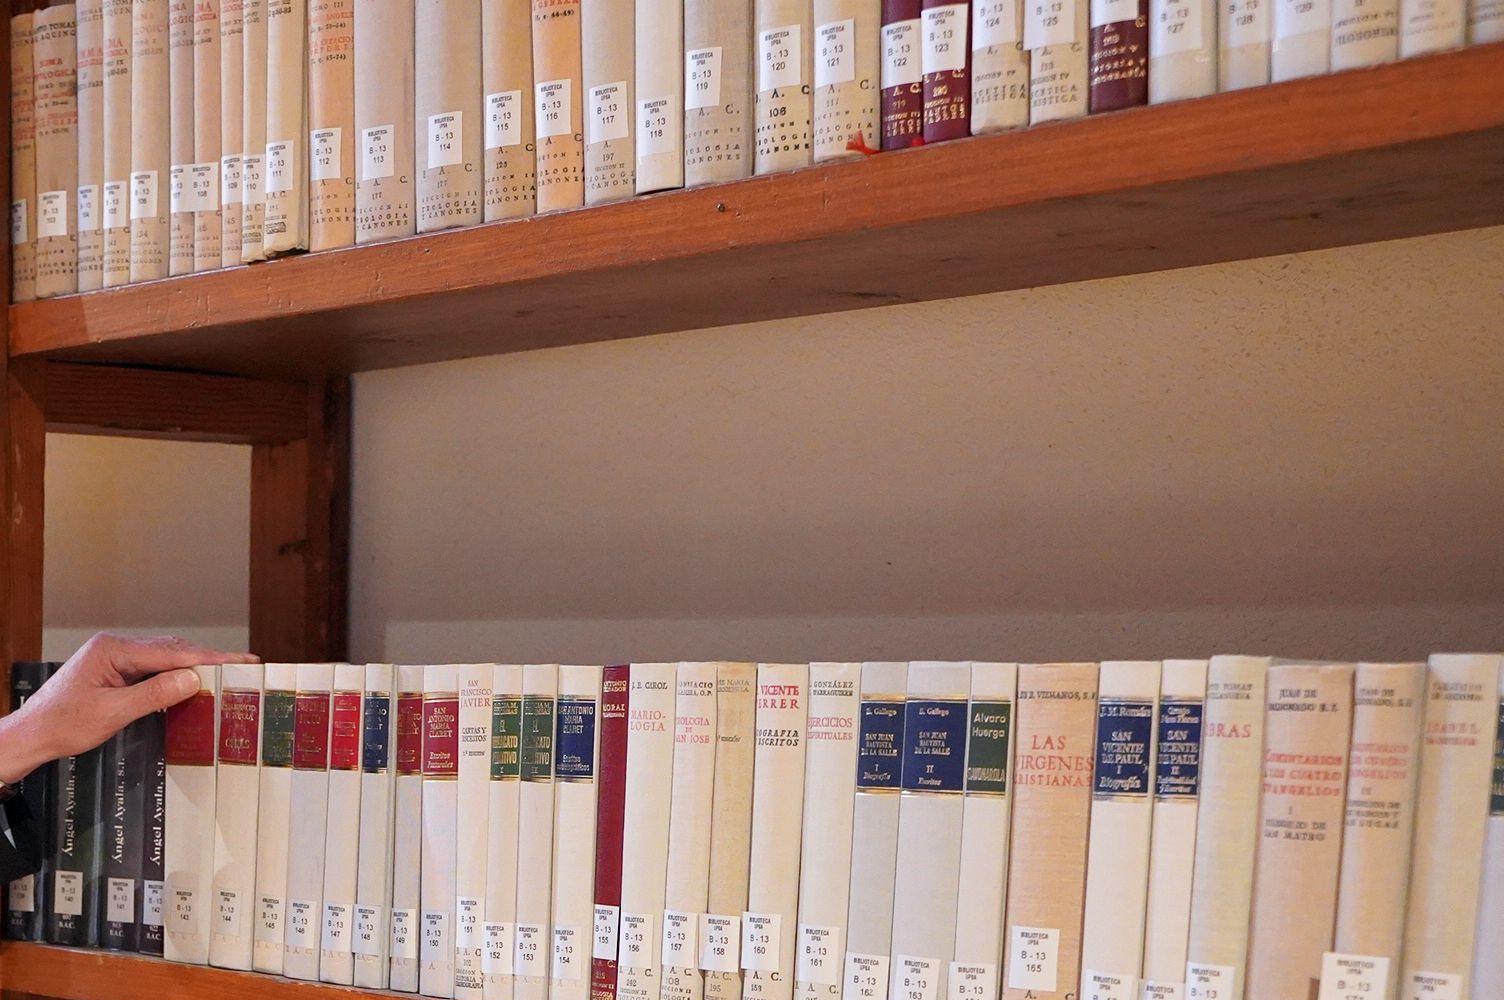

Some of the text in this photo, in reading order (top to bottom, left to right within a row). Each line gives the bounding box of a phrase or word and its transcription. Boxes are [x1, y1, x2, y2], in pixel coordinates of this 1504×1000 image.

[985, 17, 1001, 27] 124
[934, 43, 949, 53] 123
[771, 61, 786, 71] 120
[826, 57, 840, 66] 121
[893, 57, 907, 67] 122
[695, 82, 709, 91] 119
[545, 112, 558, 121] 116
[602, 115, 615, 124] 117
[497, 123, 509, 131] 115
[649, 129, 663, 138] 118
[439, 142, 452, 151] 114
[467, 680, 479, 688] SAN
[813, 679, 854, 689] GONZÁLEZ
[760, 684, 800, 696] VICENTE
[460, 698, 491, 708] JAVIER
[758, 698, 800, 709] ERRER
[630, 709, 667, 720] MARIO-
[973, 712, 1007, 723] Alvaro
[630, 721, 665, 731] LOGIA
[972, 727, 1006, 739] Huerga
[1111, 731, 1132, 741] SAN
[1167, 729, 1188, 741] SAN
[689, 734, 710, 744] JOSE
[1031, 734, 1067, 750] LAS
[1101, 742, 1144, 754] VICENTE
[1115, 753, 1143, 765] PAUL
[111, 825, 124, 863] Ángel
[149, 826, 163, 866] Ángel
[463, 926, 473, 934] 151
[360, 932, 371, 941] 148
[1020, 931, 1049, 939] BIBLIOTECA
[395, 936, 405, 944] 149
[429, 939, 439, 947] 150
[598, 936, 609, 944] 155
[628, 944, 640, 952] 156
[670, 943, 682, 951] 157
[713, 947, 725, 956] 158
[754, 946, 766, 955] 160
[489, 951, 501, 960] 152
[522, 953, 534, 961] 153
[559, 956, 570, 964] 154
[810, 958, 823, 967] 161
[853, 957, 880, 966] BIBLIOTECA
[957, 966, 986, 974] BIBLIOTECA
[1026, 964, 1042, 973] 165
[959, 985, 965, 993] B
[974, 987, 984, 995] 13
[908, 991, 922, 1000] 163
